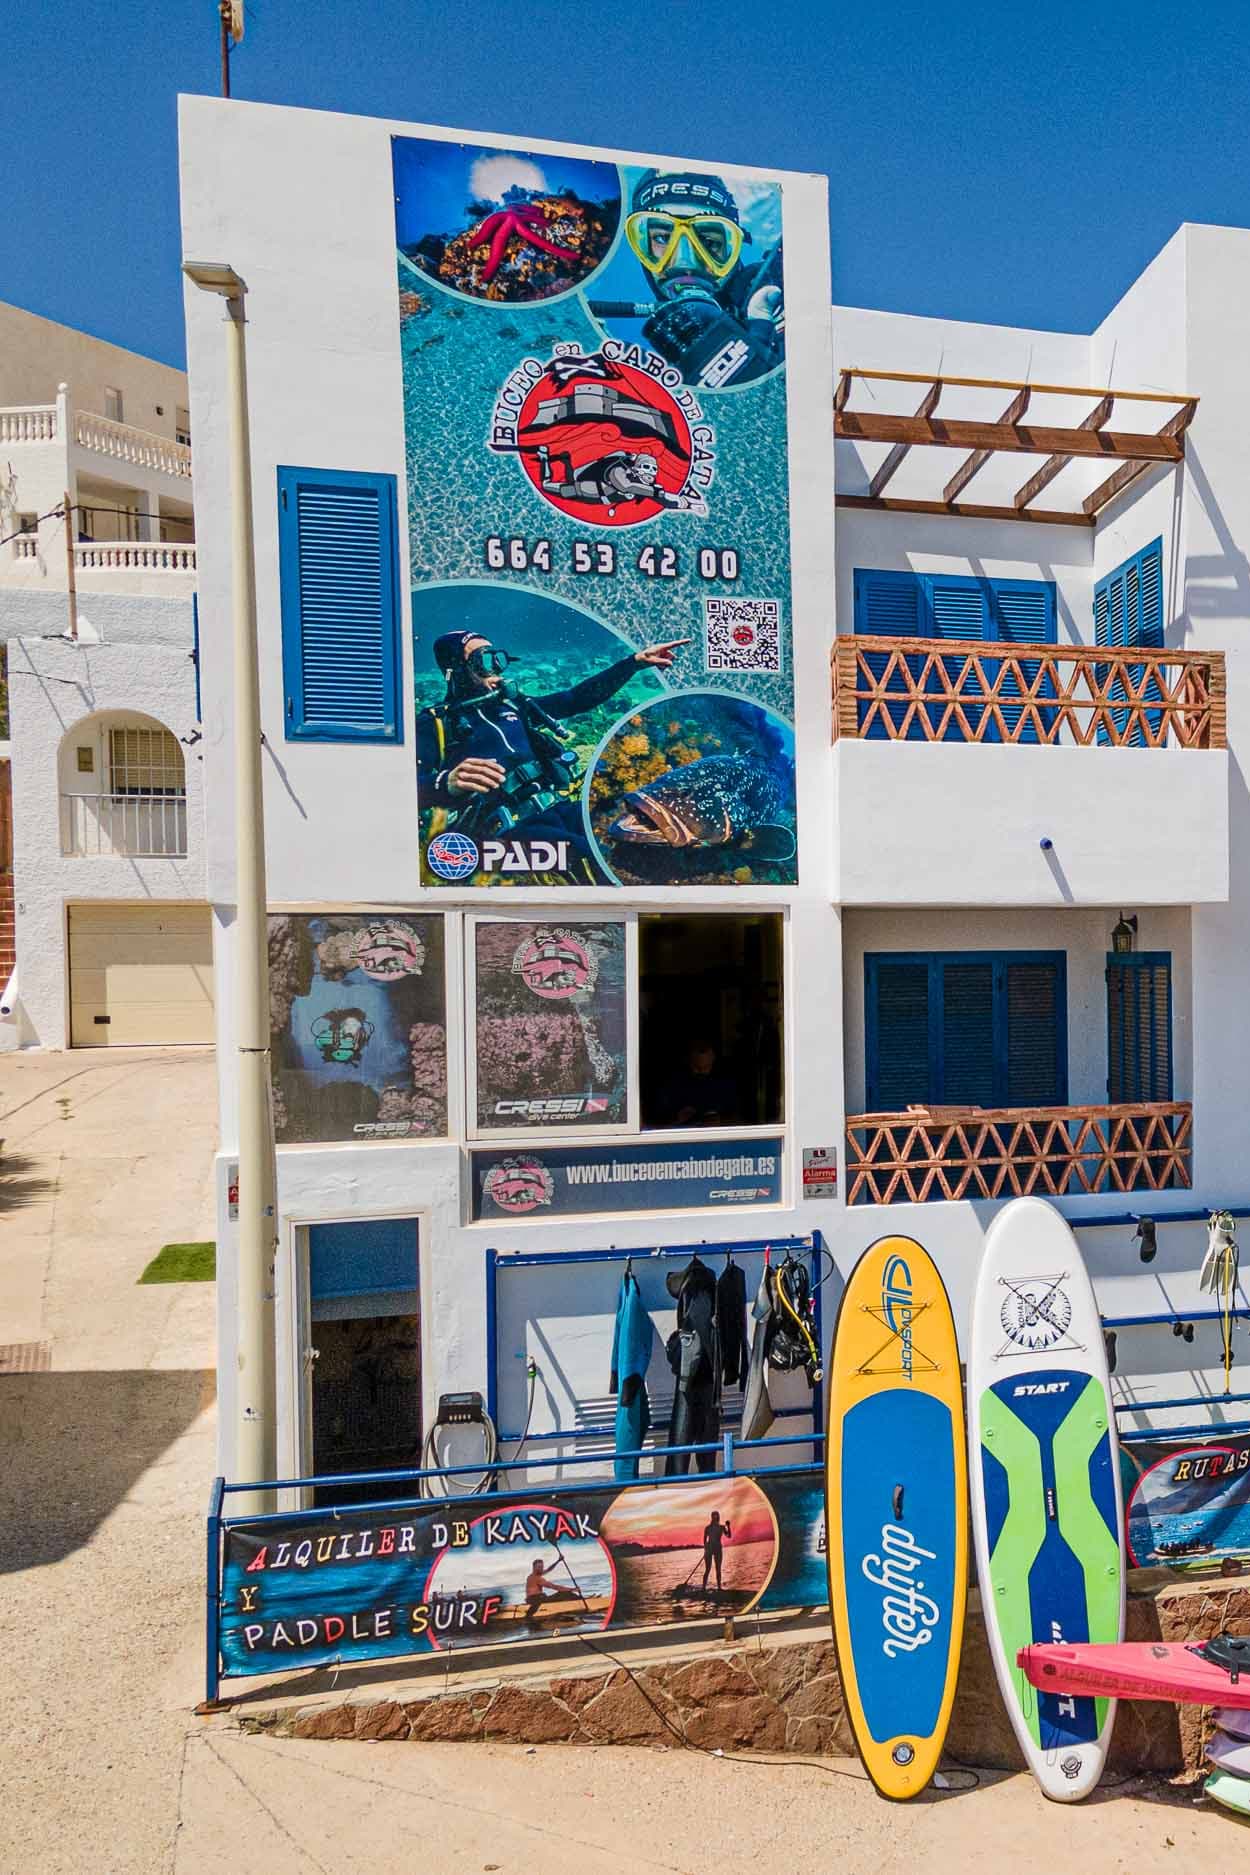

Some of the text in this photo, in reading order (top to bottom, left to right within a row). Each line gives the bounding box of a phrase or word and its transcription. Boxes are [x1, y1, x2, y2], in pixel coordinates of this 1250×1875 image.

[640, 182, 728, 207] CRESSI
[555, 343, 580, 357] en
[601, 340, 682, 388] CABO
[493, 359, 544, 445] BUCEO
[675, 390, 702, 422] DE
[680, 426, 715, 501] GATA
[487, 538, 738, 579] 664 53 42 00
[482, 840, 567, 872] PADI
[494, 1099, 585, 1115] CRESSI
[566, 1156, 776, 1184] www.buceoencabodegata.es
[1013, 1381, 1071, 1397] START
[1173, 1449, 1250, 1481] RUTAS
[246, 1513, 598, 1572] ALQUILER DE KAYAK
[240, 1586, 259, 1612] Y
[862, 1523, 940, 1658] drifter
[244, 1597, 501, 1648] PADDLE SURF
